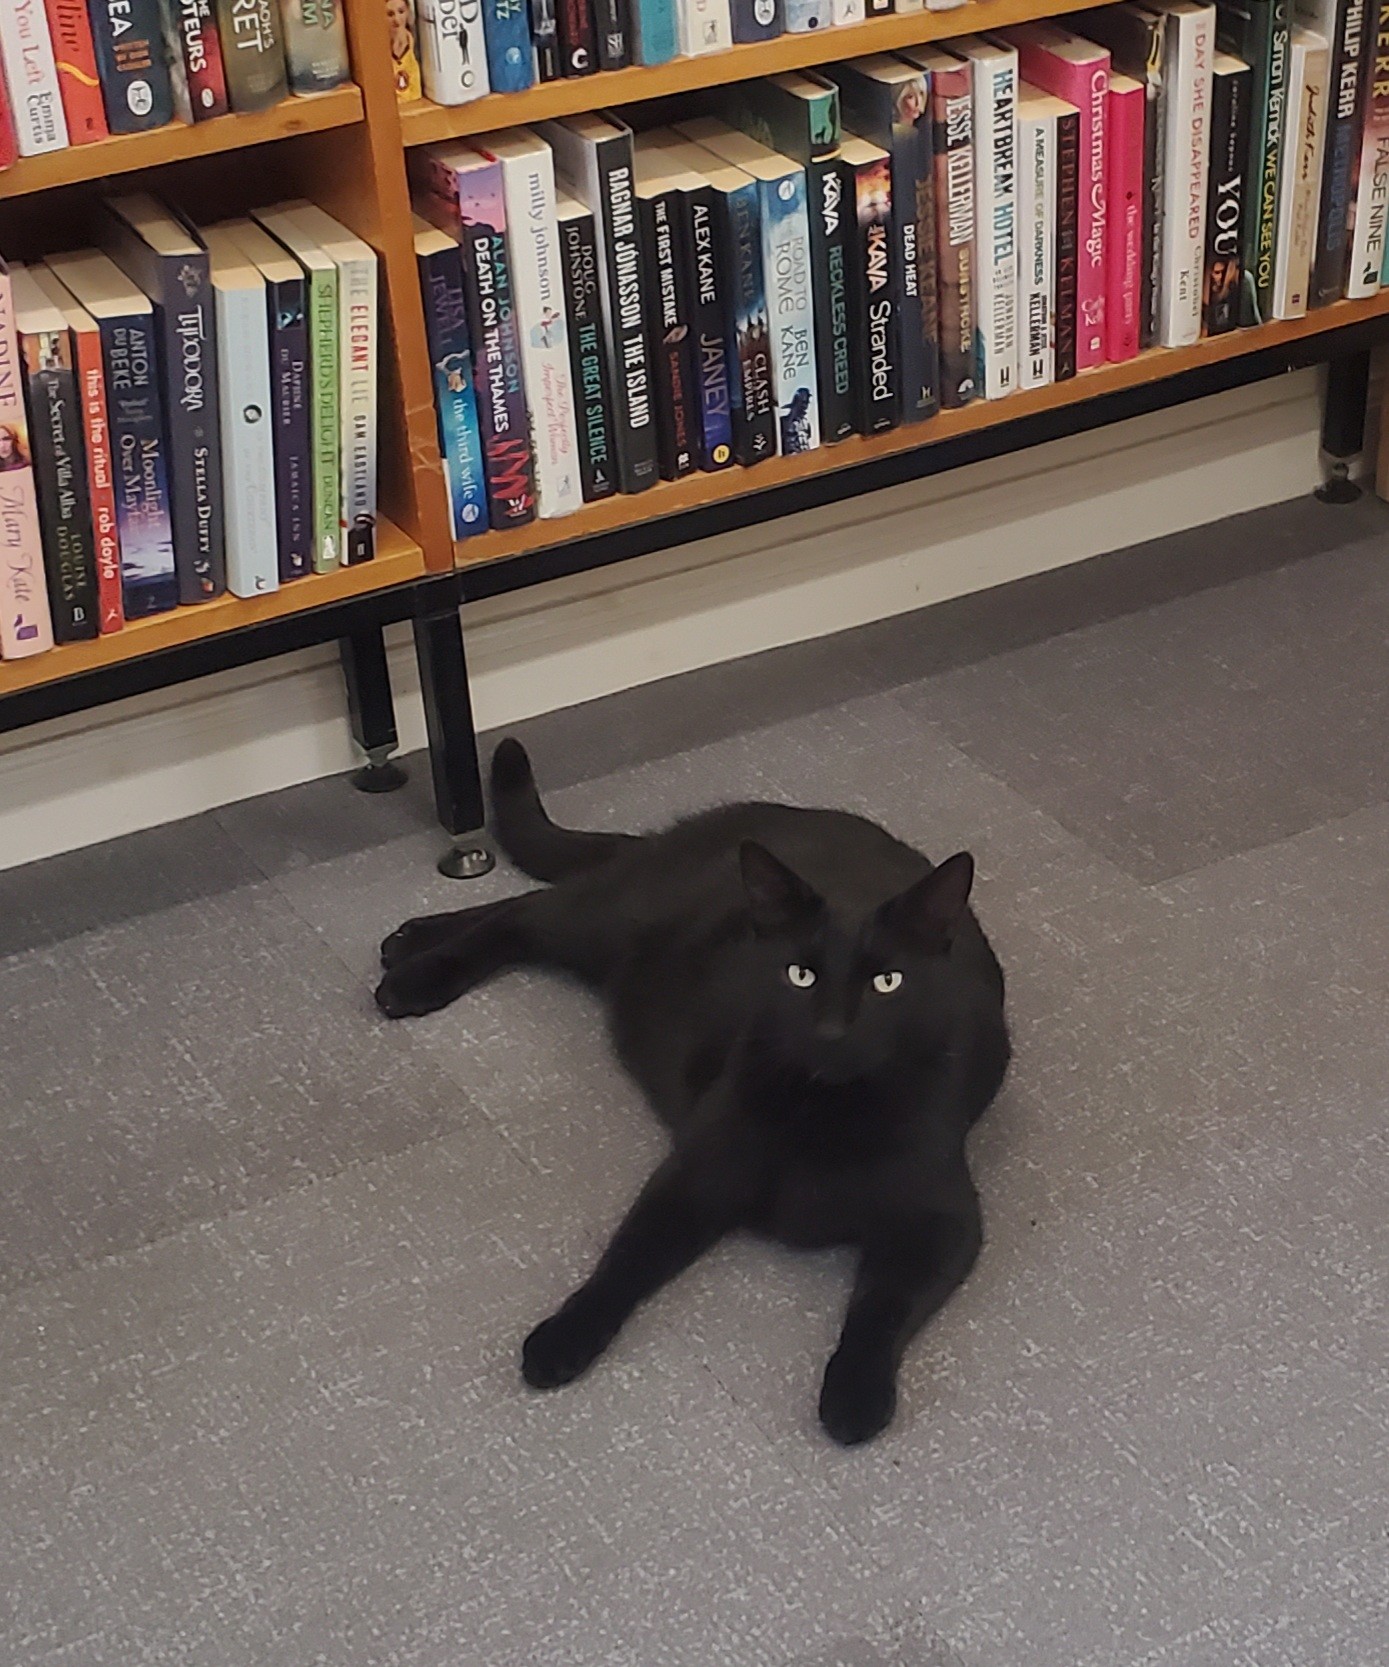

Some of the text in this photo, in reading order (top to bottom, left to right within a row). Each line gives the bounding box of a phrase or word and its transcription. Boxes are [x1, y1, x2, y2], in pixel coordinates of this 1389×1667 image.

[108, 0, 133, 37] EA
[1195, 33, 1206, 70] DAY
[22, 45, 45, 85] Left
[1271, 29, 1289, 84] Simon
[1337, 61, 1359, 119] KERR
[28, 94, 43, 145] Curtis
[40, 91, 57, 142] Emma
[1192, 76, 1205, 112] SHE
[993, 69, 1014, 199] HEARTBREAK
[946, 97, 975, 246] JESSE KELLERMAN
[1061, 118, 1076, 225] STEPHEN
[1086, 69, 1108, 268] Christmas Magic
[1188, 116, 1204, 240] DISAPPEARED
[1371, 137, 1389, 202] FALSE
[527, 173, 553, 300] milly johnson
[821, 172, 842, 236] KAVA
[994, 201, 1015, 267] HOTEL
[1034, 127, 1047, 286] A MEASURE OF DARKNESS
[1212, 174, 1242, 257] YOU
[1257, 149, 1278, 288] WE CAN SEE YOU
[1366, 204, 1385, 254] NINE
[566, 226, 588, 321] JOHNSTONE
[581, 245, 597, 293] DOUG
[608, 167, 642, 329] RAGNAR JÓNASSON
[654, 201, 681, 328] THE FIRST MISTAKE
[693, 204, 717, 305] ALEX KANE
[776, 241, 795, 315] ROME
[792, 236, 808, 311] ROAD TO
[864, 233, 888, 293] KAVA
[904, 224, 918, 297] DEAD HEAT
[447, 287, 465, 330] LISA
[493, 236, 520, 393] ALAN JOHNSON
[957, 250, 971, 353] SUNSTROKE
[1179, 270, 1190, 302] Kent
[350, 304, 369, 372] ELEGANT
[474, 238, 510, 433] DEATH ON THE THAMES
[622, 333, 646, 367] THE
[780, 325, 797, 380] KANE
[794, 329, 810, 368] BEN
[829, 246, 850, 395] RECKLESS CREED
[867, 300, 893, 400] Stranded
[993, 293, 1006, 355] KELLERMAN
[1029, 291, 1041, 357] KELLERMAN
[109, 327, 131, 390] DU BEKE
[129, 327, 149, 386] ANTON
[699, 333, 730, 416] JANEY
[753, 352, 771, 415] CLASH
[50, 400, 68, 444] Secret
[542, 363, 560, 466] Imperfect Woman
[579, 323, 608, 465] THE GREAT SILENCE
[626, 371, 650, 429] ISLAND
[86, 369, 112, 488] this is the ritual
[120, 433, 136, 471] Over
[320, 391, 336, 466] DELIGHT
[452, 399, 479, 500] the third wife
[57, 456, 74, 487] Villa
[60, 488, 79, 520] Alba
[138, 438, 165, 528] Moonlight
[194, 447, 212, 553] STELLA DUFFY
[321, 474, 333, 530] DUNCAN
[353, 445, 368, 507] EASTLAND
[6, 483, 36, 603] Mary Kate
[56, 525, 76, 603] DOUGLAS
[70, 532, 88, 588] LOUISE
[99, 507, 118, 579] rob doyle
